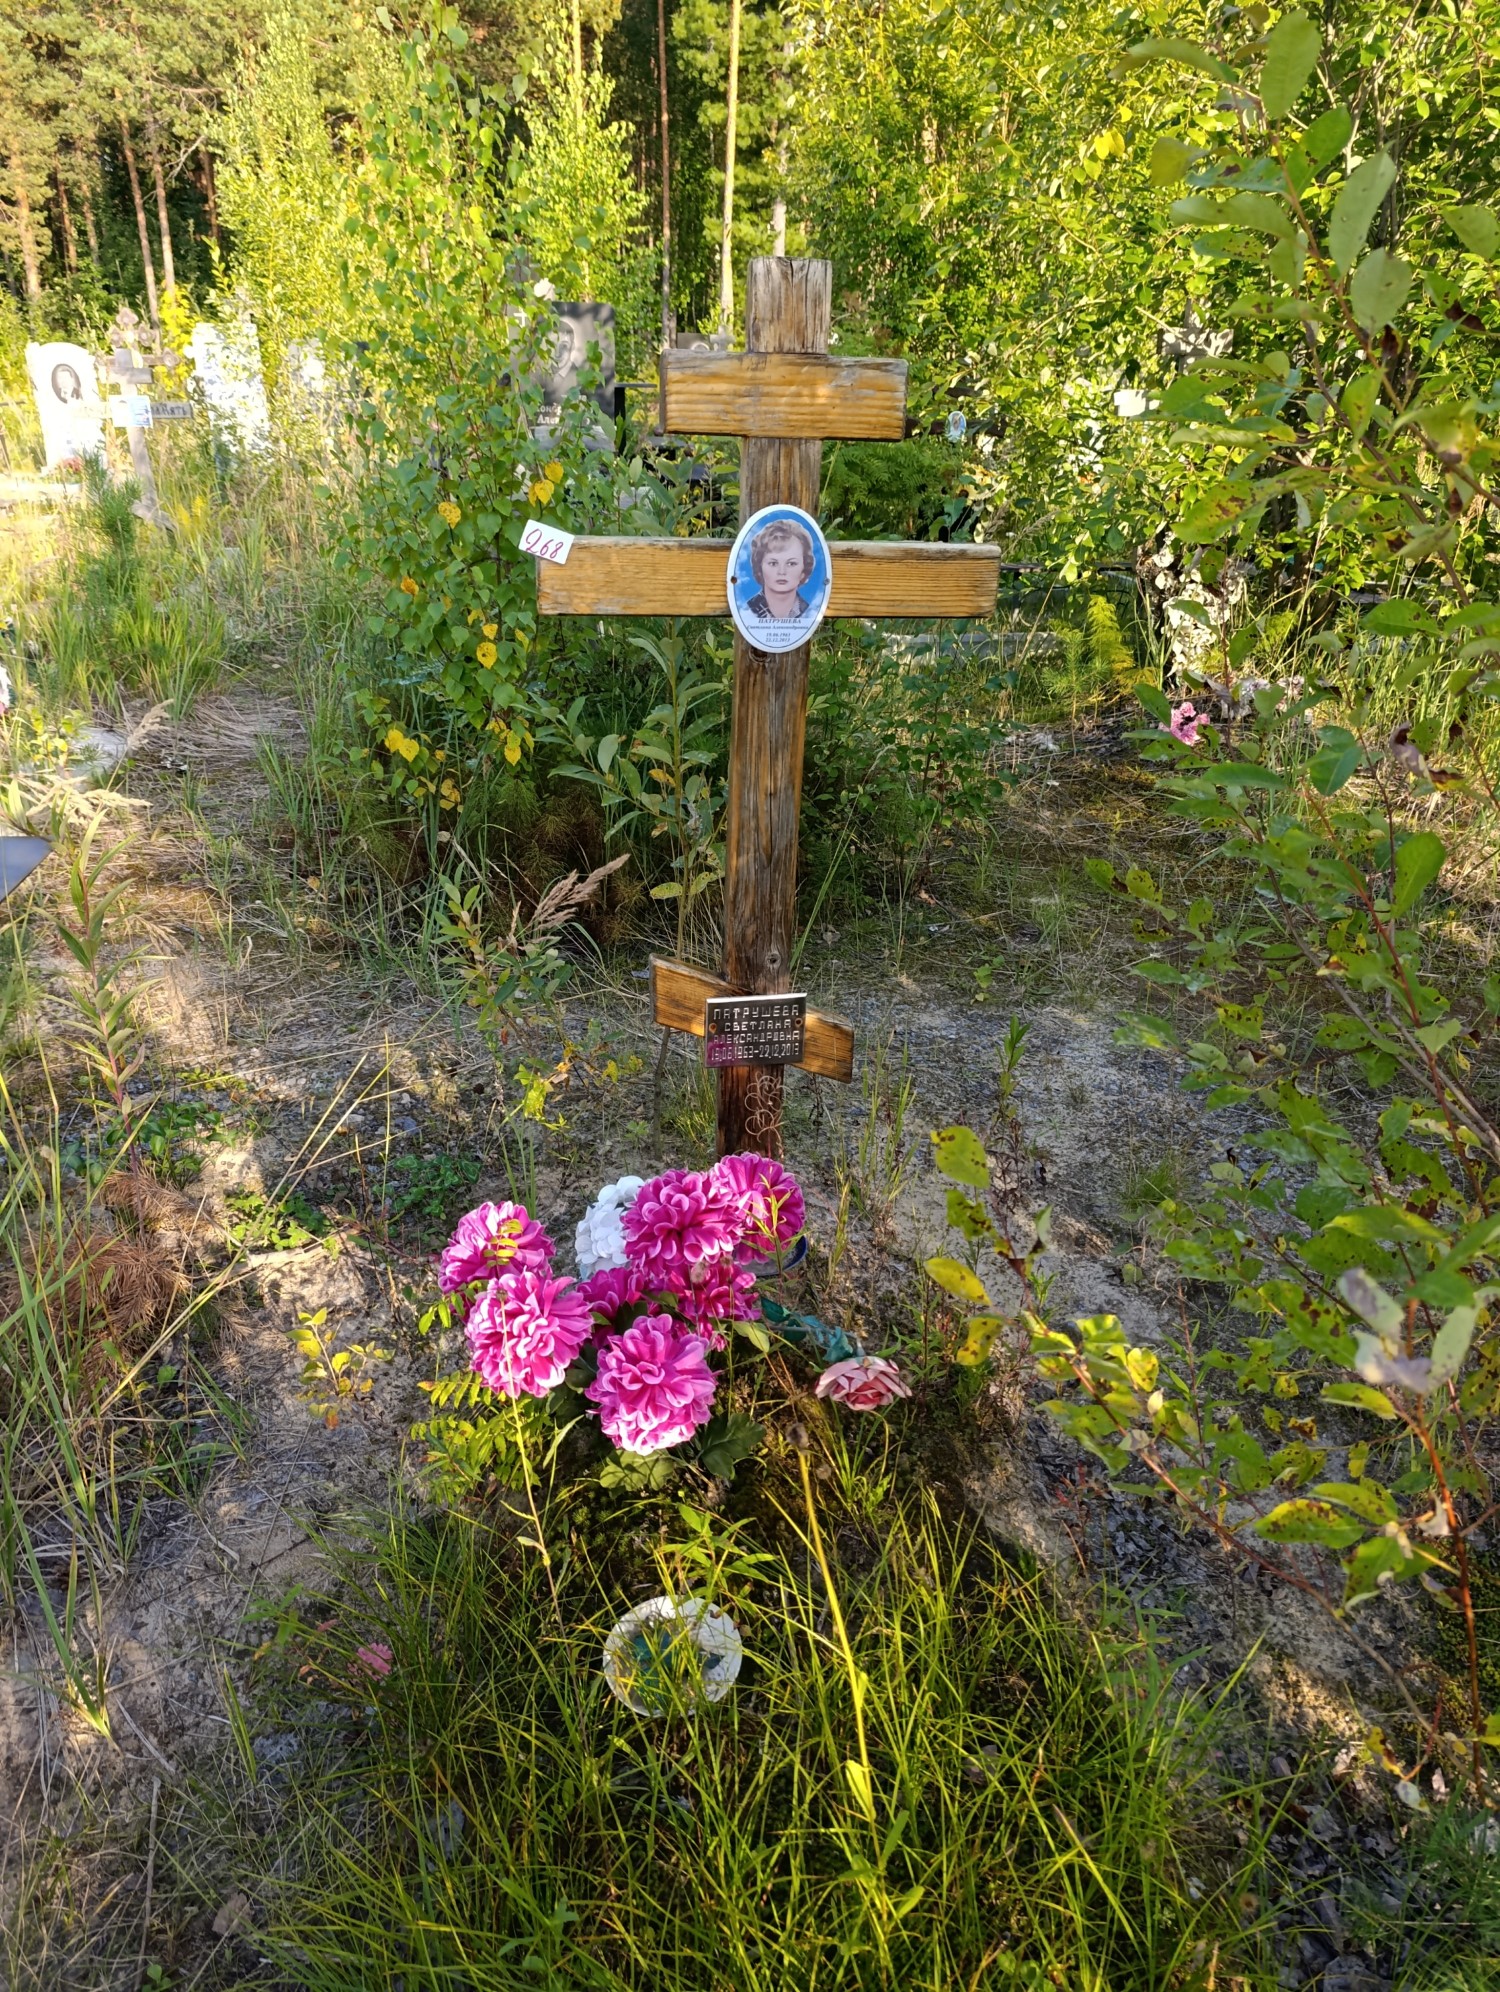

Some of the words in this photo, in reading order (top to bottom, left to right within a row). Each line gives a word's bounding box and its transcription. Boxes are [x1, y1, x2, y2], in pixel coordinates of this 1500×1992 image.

[525, 528, 564, 559] 268
[713, 1004, 799, 1020] ПАТРУШЕВА
[724, 1019, 791, 1032] СВЕТЛАНА
